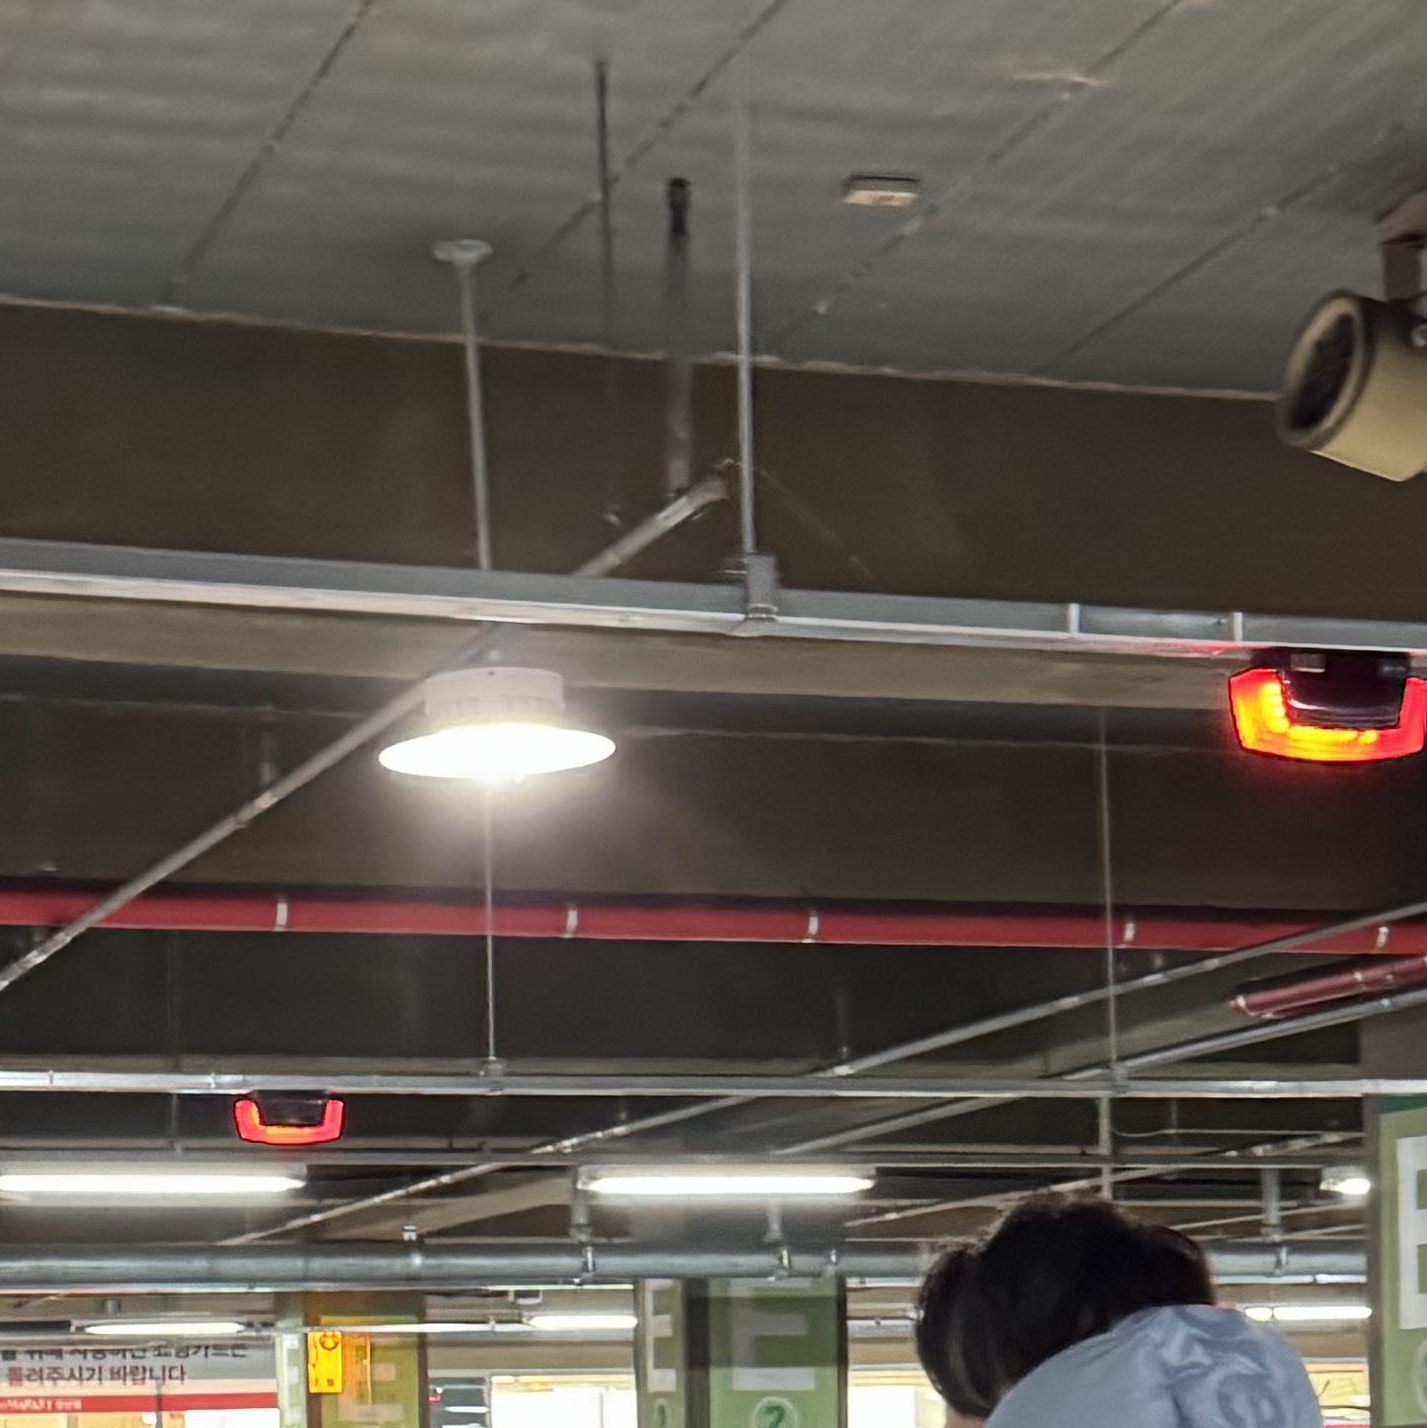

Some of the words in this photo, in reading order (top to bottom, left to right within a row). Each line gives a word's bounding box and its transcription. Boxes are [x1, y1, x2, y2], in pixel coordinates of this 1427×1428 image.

[109, 1363, 186, 1386] 바랍니다
[645, 1279, 676, 1392] E
[729, 1277, 815, 1391] E
